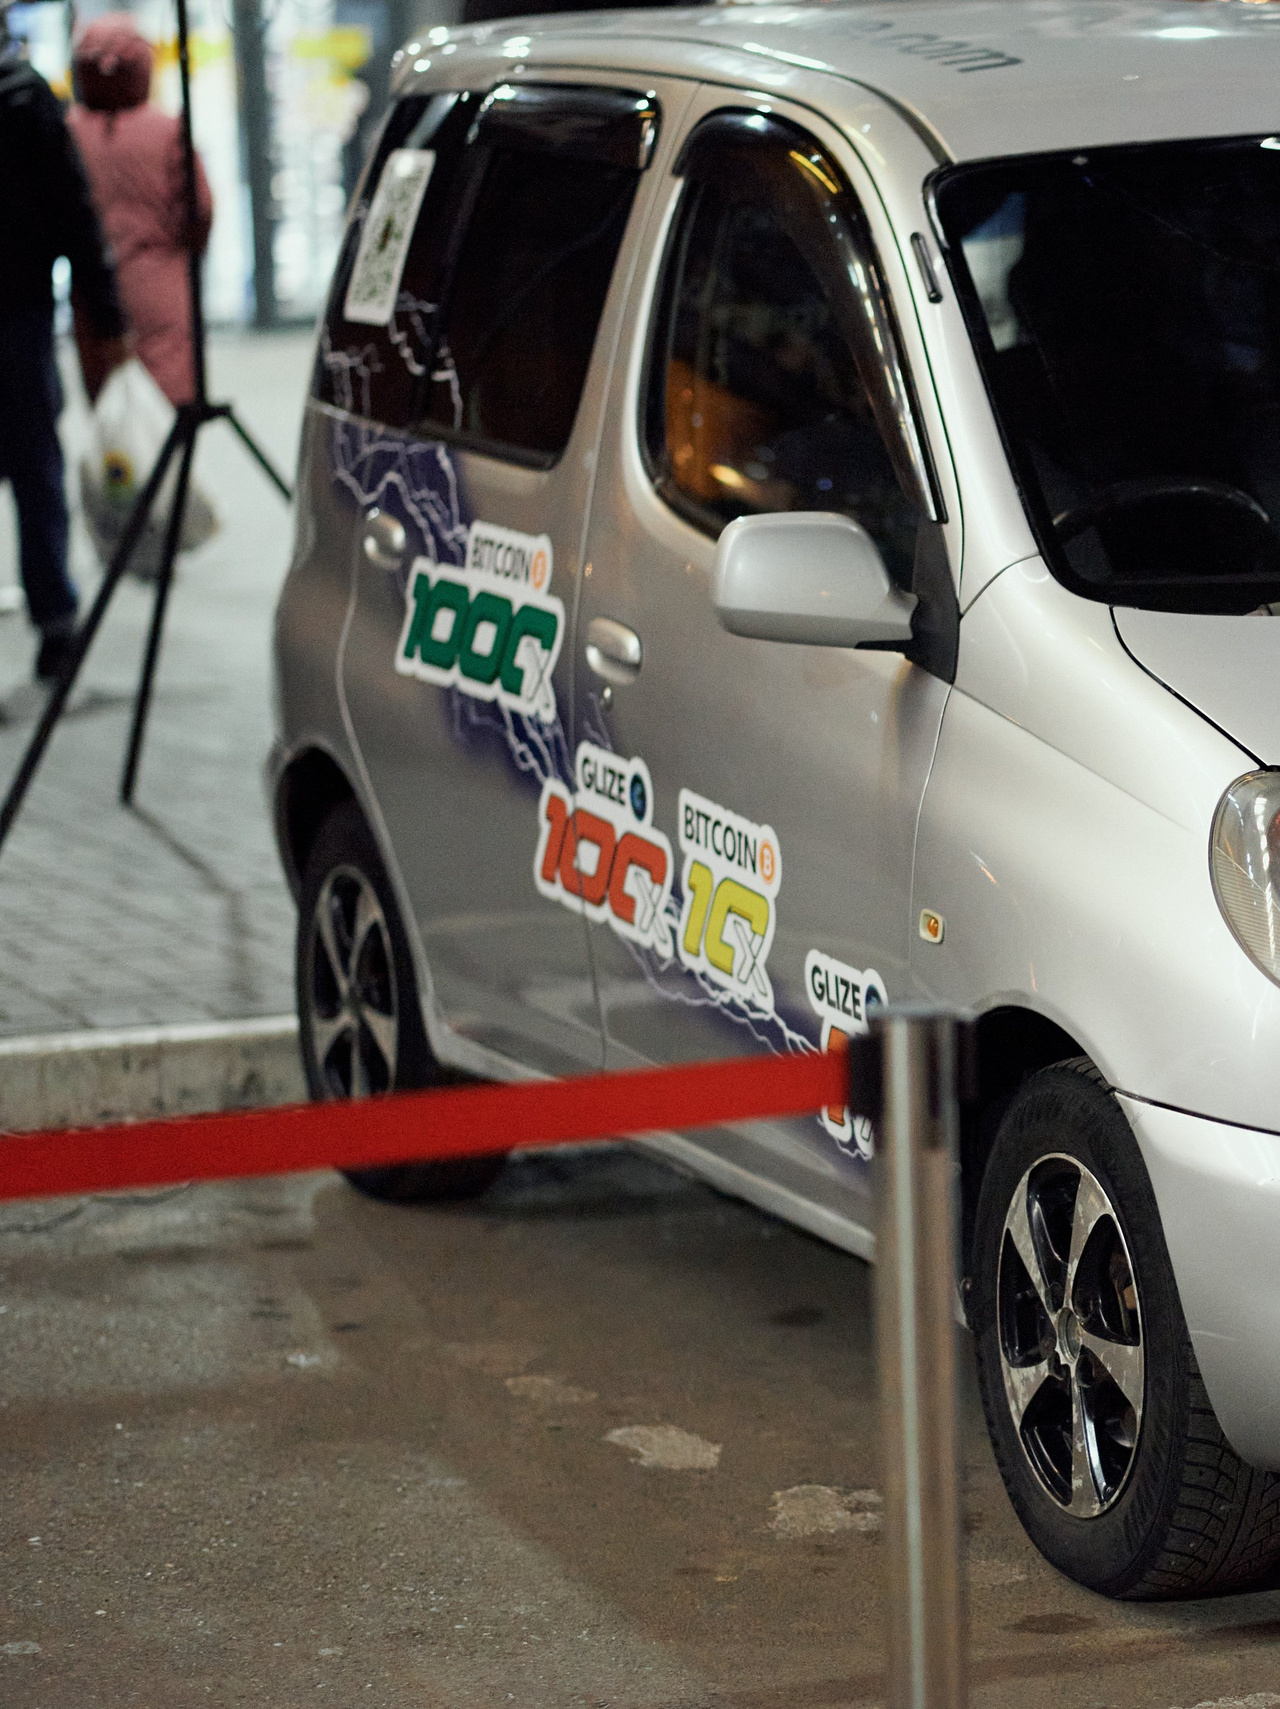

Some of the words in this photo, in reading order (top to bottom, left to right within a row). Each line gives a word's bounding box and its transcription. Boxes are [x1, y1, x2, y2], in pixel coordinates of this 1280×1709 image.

[472, 536, 530, 583] BITCOIN
[581, 757, 626, 806] GLIZE
[685, 804, 757, 875] BITCOIN
[811, 965, 863, 1022] GLIZE
